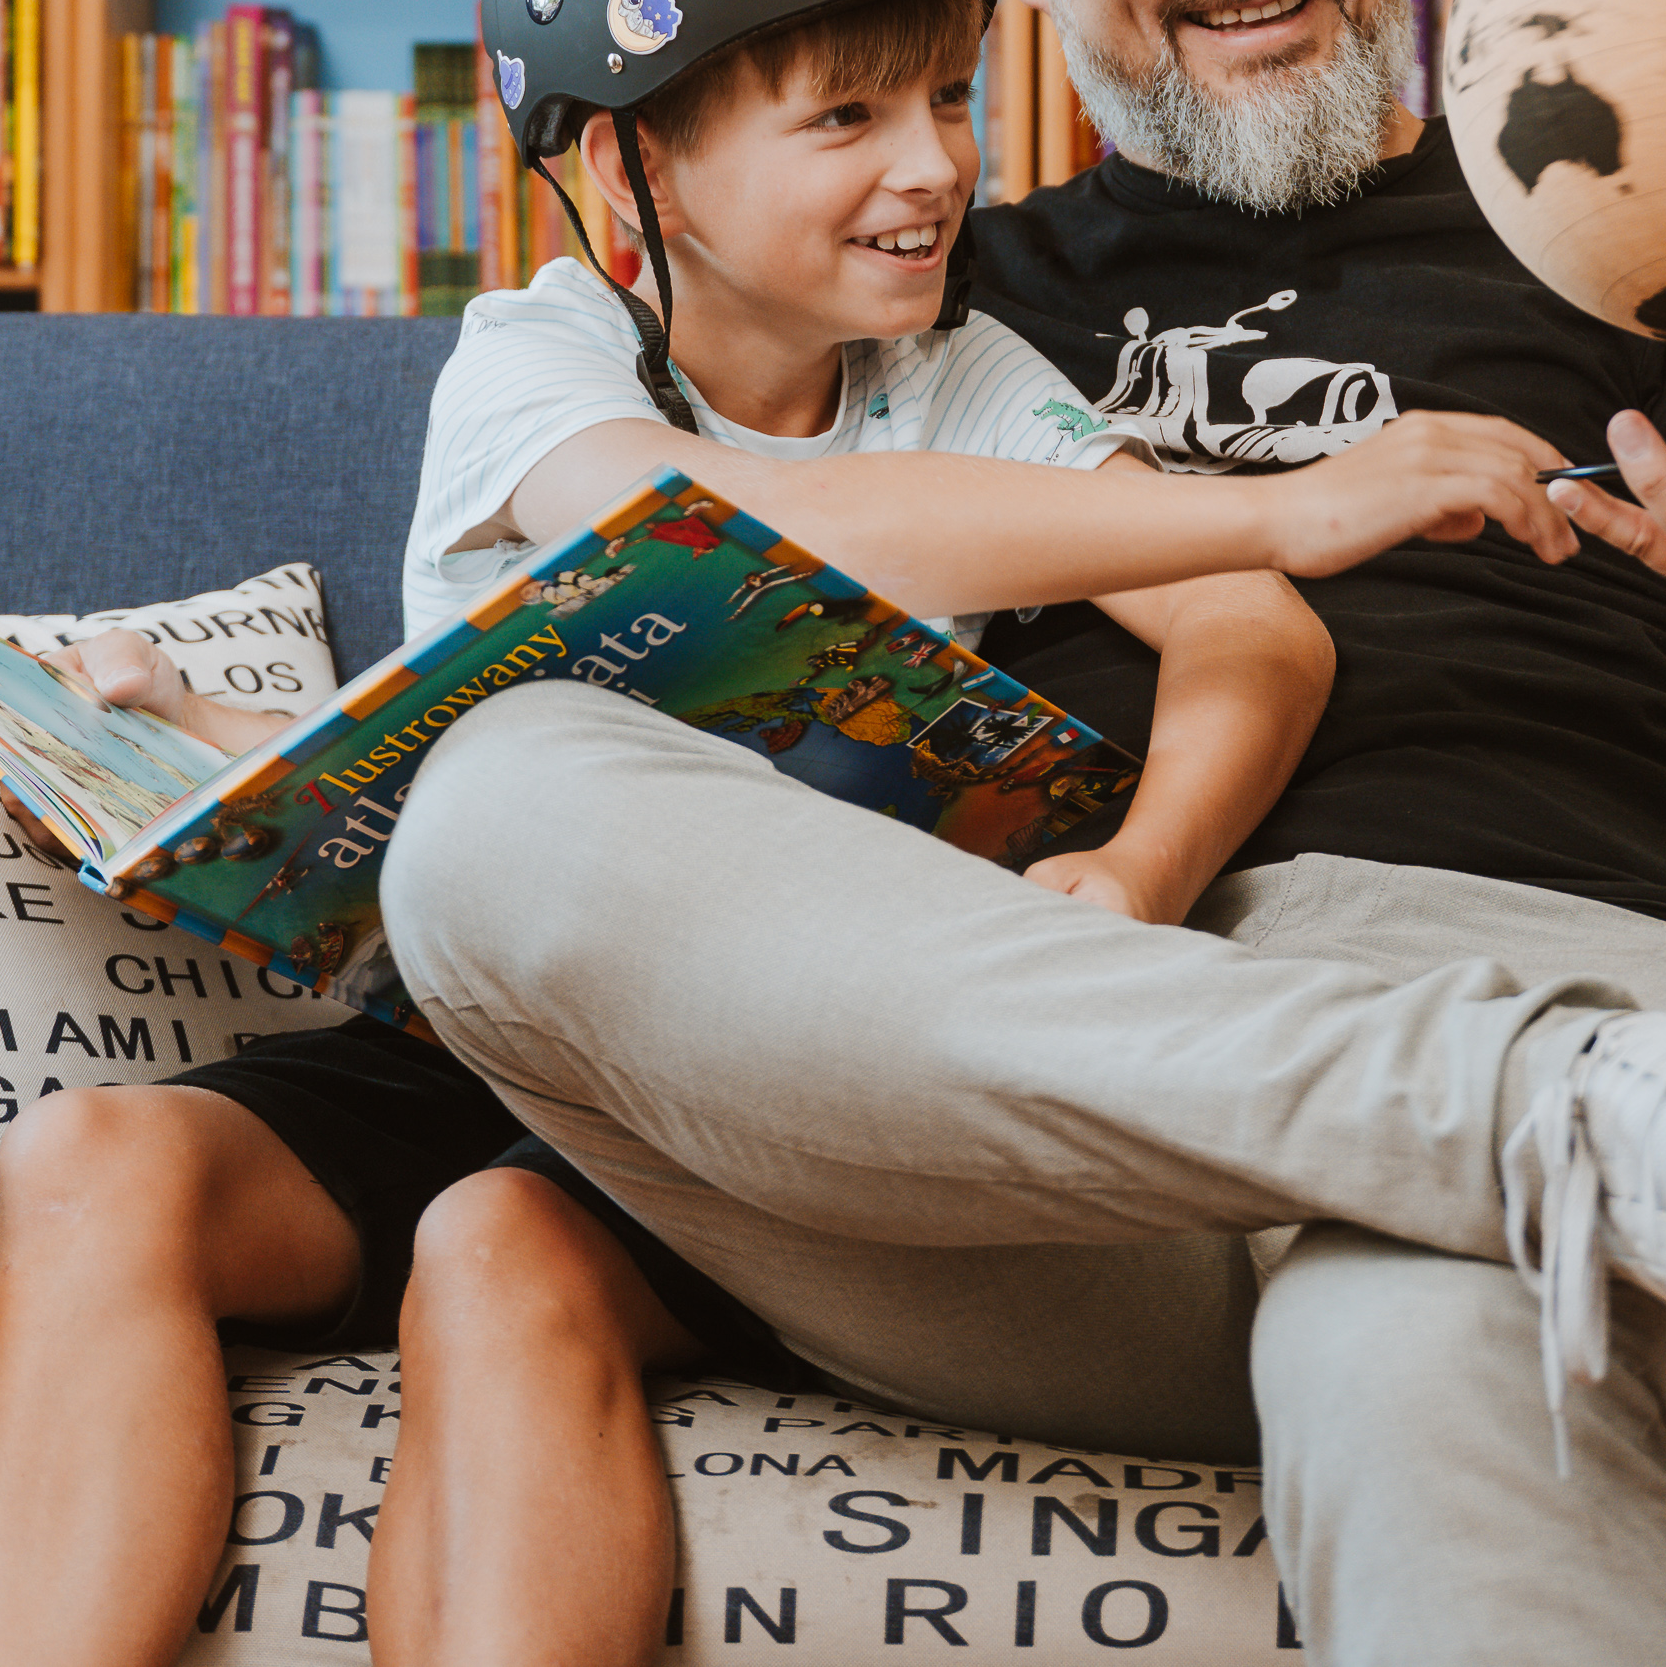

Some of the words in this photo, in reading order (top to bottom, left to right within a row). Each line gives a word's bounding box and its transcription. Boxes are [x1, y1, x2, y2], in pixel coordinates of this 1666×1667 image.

[535, 611, 688, 686] ata
[294, 623, 569, 817] Ilustrowany
[318, 783, 414, 869] atl
[105, 953, 323, 1000] CHIC
[884, 1576, 1171, 1650] RIO
